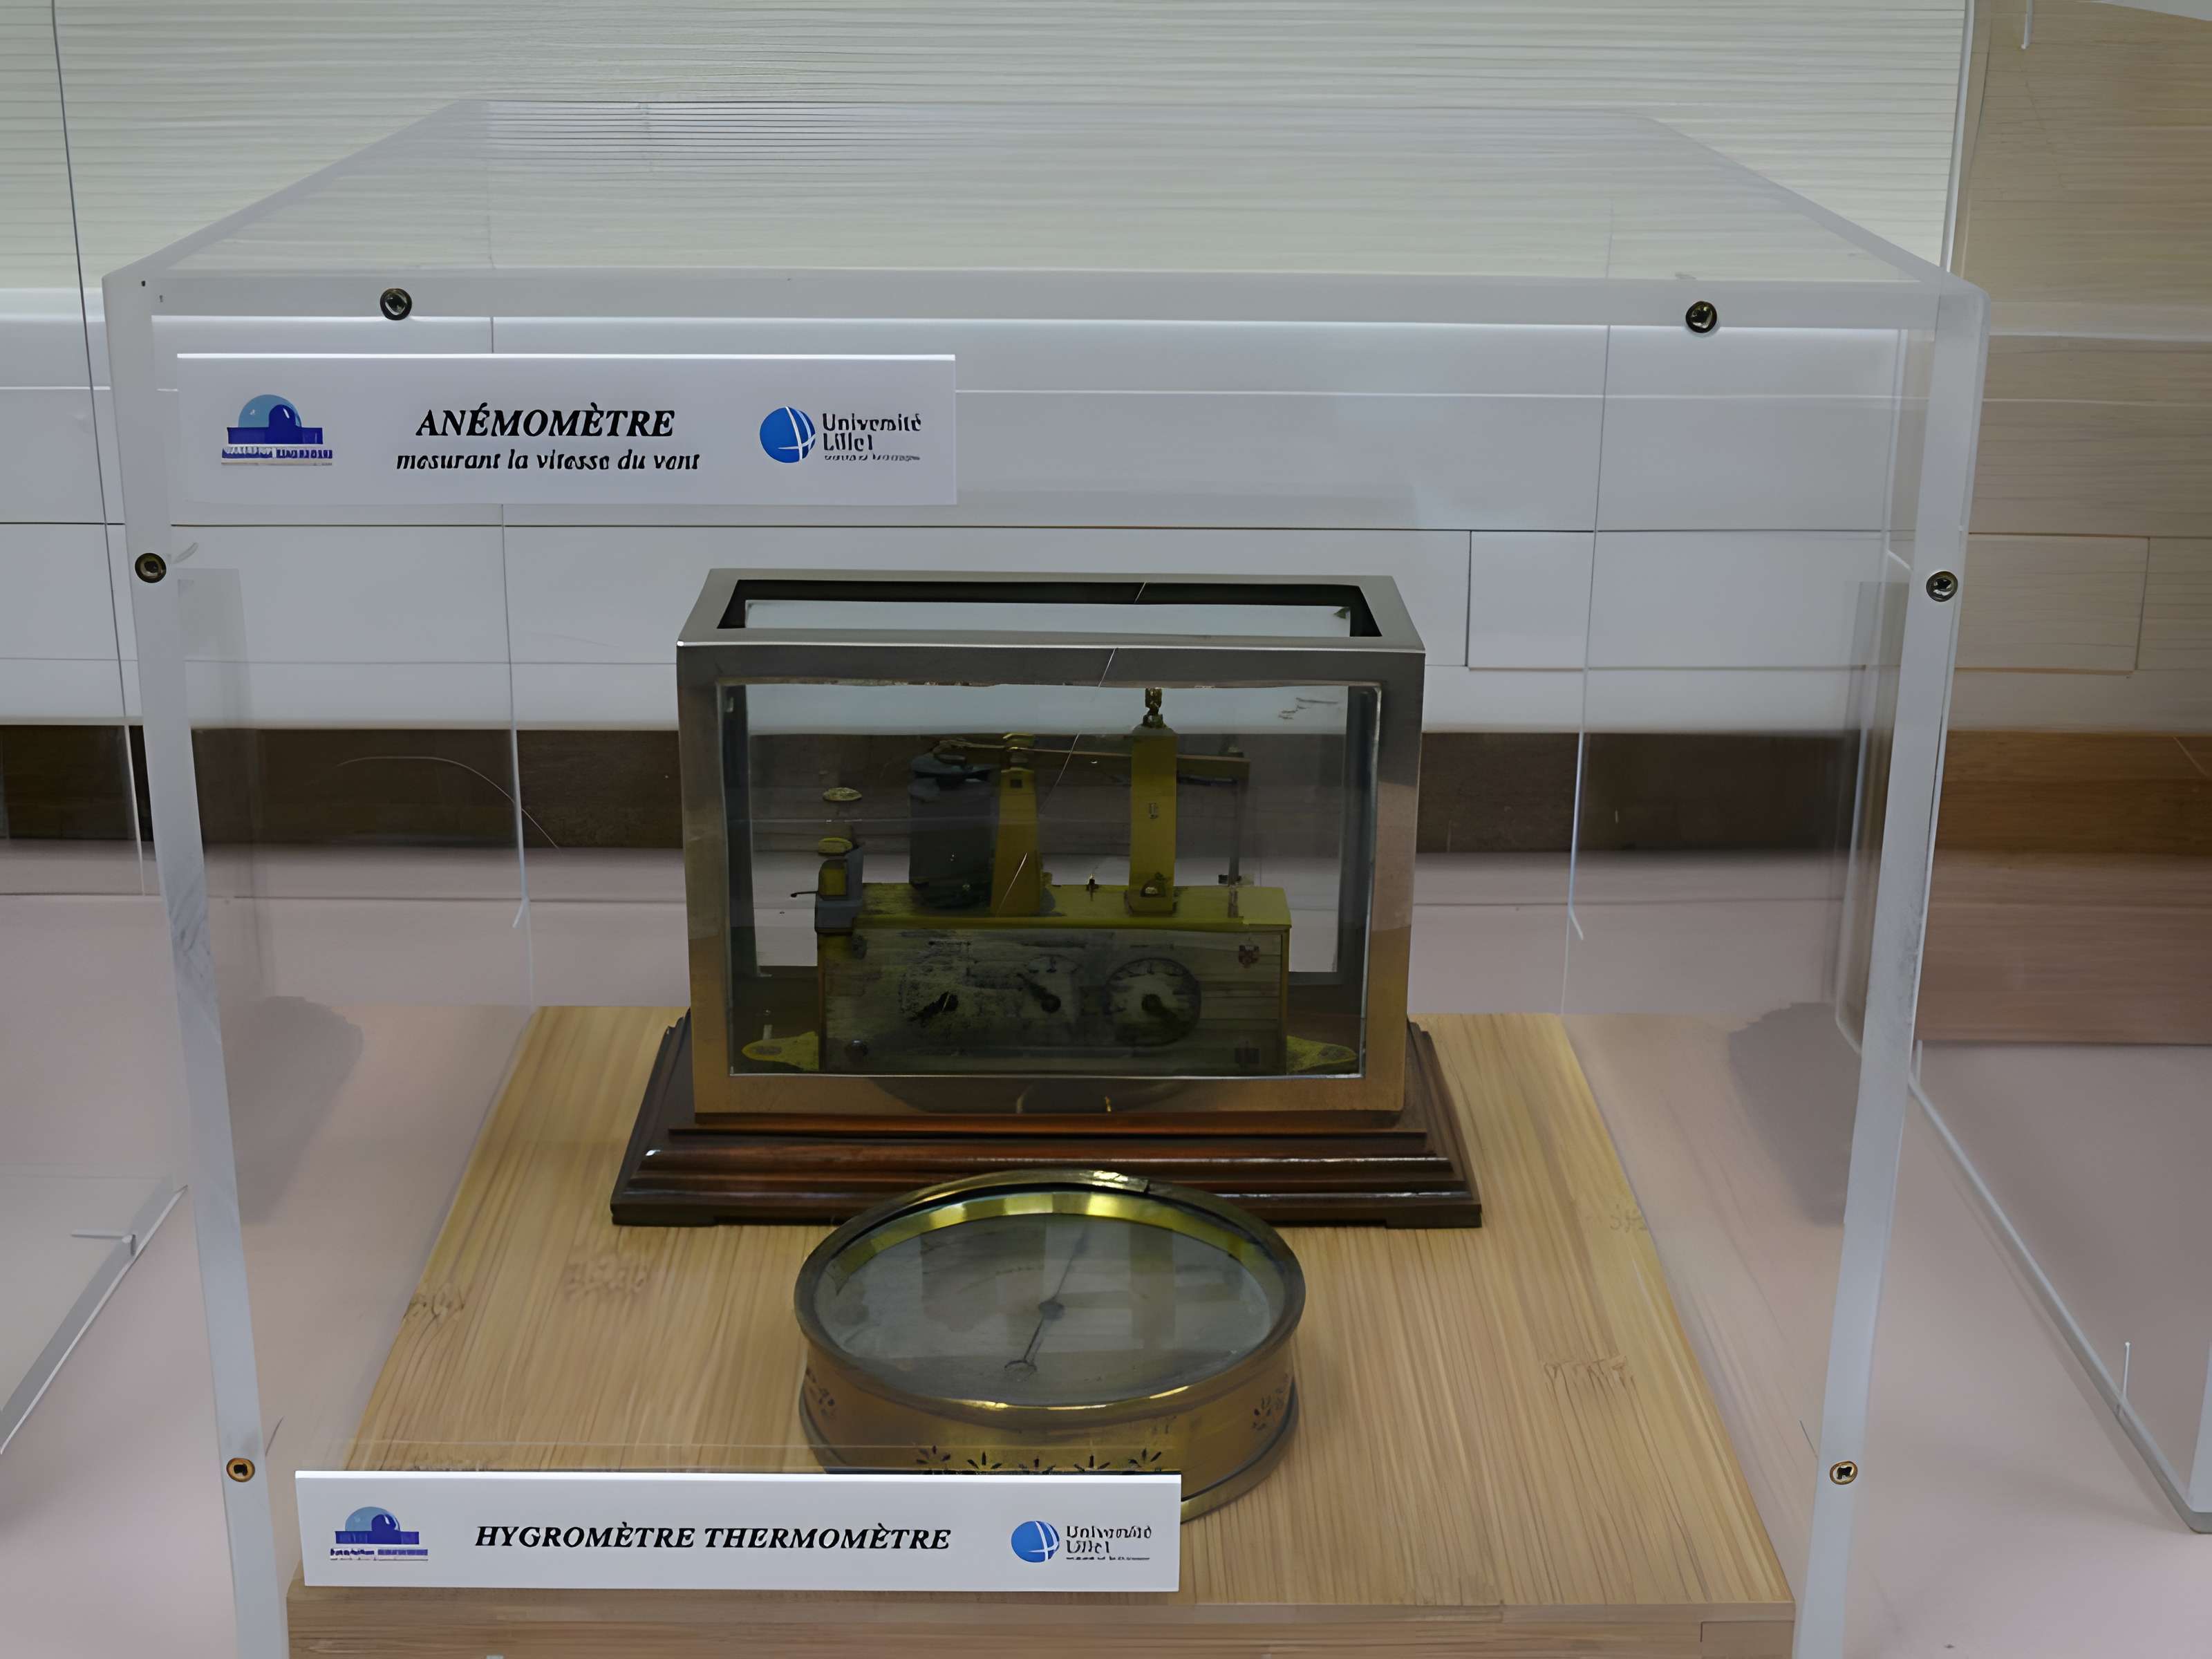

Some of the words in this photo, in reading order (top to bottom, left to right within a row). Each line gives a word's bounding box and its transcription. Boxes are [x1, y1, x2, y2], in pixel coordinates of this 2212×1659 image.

[415, 402, 675, 437] ANÉMOMÈTRE
[396, 453, 500, 469] mesurant
[507, 449, 528, 469] la
[536, 449, 609, 470] vitesse
[617, 449, 646, 469] du
[653, 453, 700, 469] vent
[475, 1521, 695, 1548] HYGROMÈTRE
[704, 1523, 950, 1549] THERMOMÈTRE
